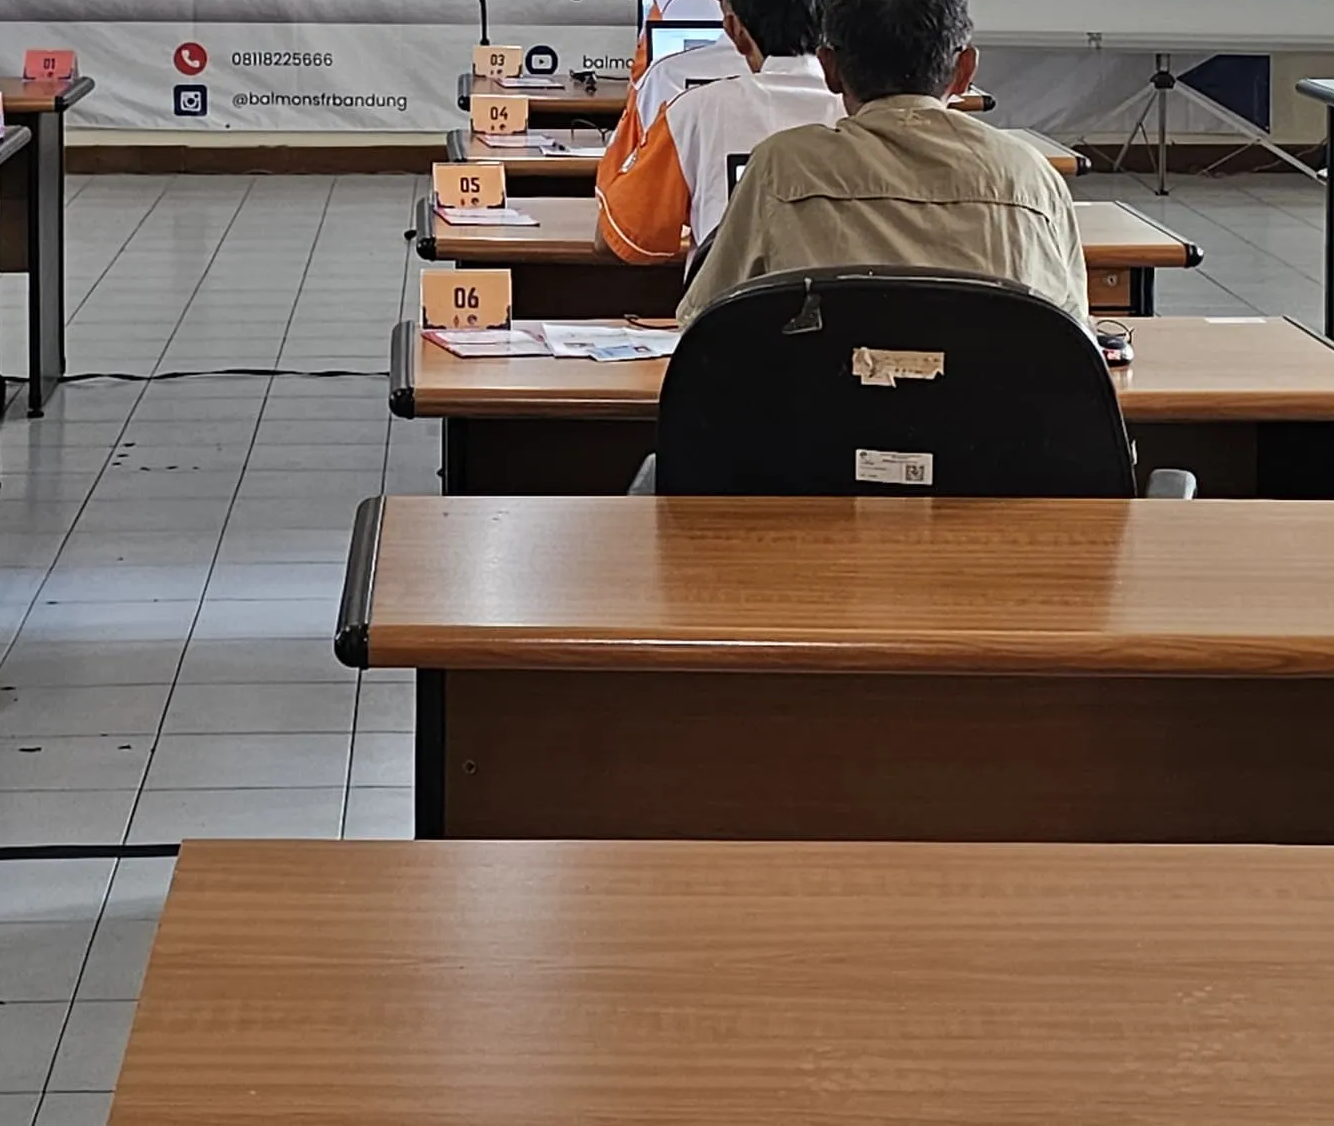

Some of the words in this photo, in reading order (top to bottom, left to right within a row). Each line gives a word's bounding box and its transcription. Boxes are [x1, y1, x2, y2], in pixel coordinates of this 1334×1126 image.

[43, 57, 56, 70] 01
[231, 51, 333, 67] 08118225666
[490, 53, 505, 67] 03
[232, 91, 408, 112] @balmonsfrbandung
[490, 106, 508, 121] 04
[460, 177, 480, 194] 05
[454, 287, 479, 309] 06
